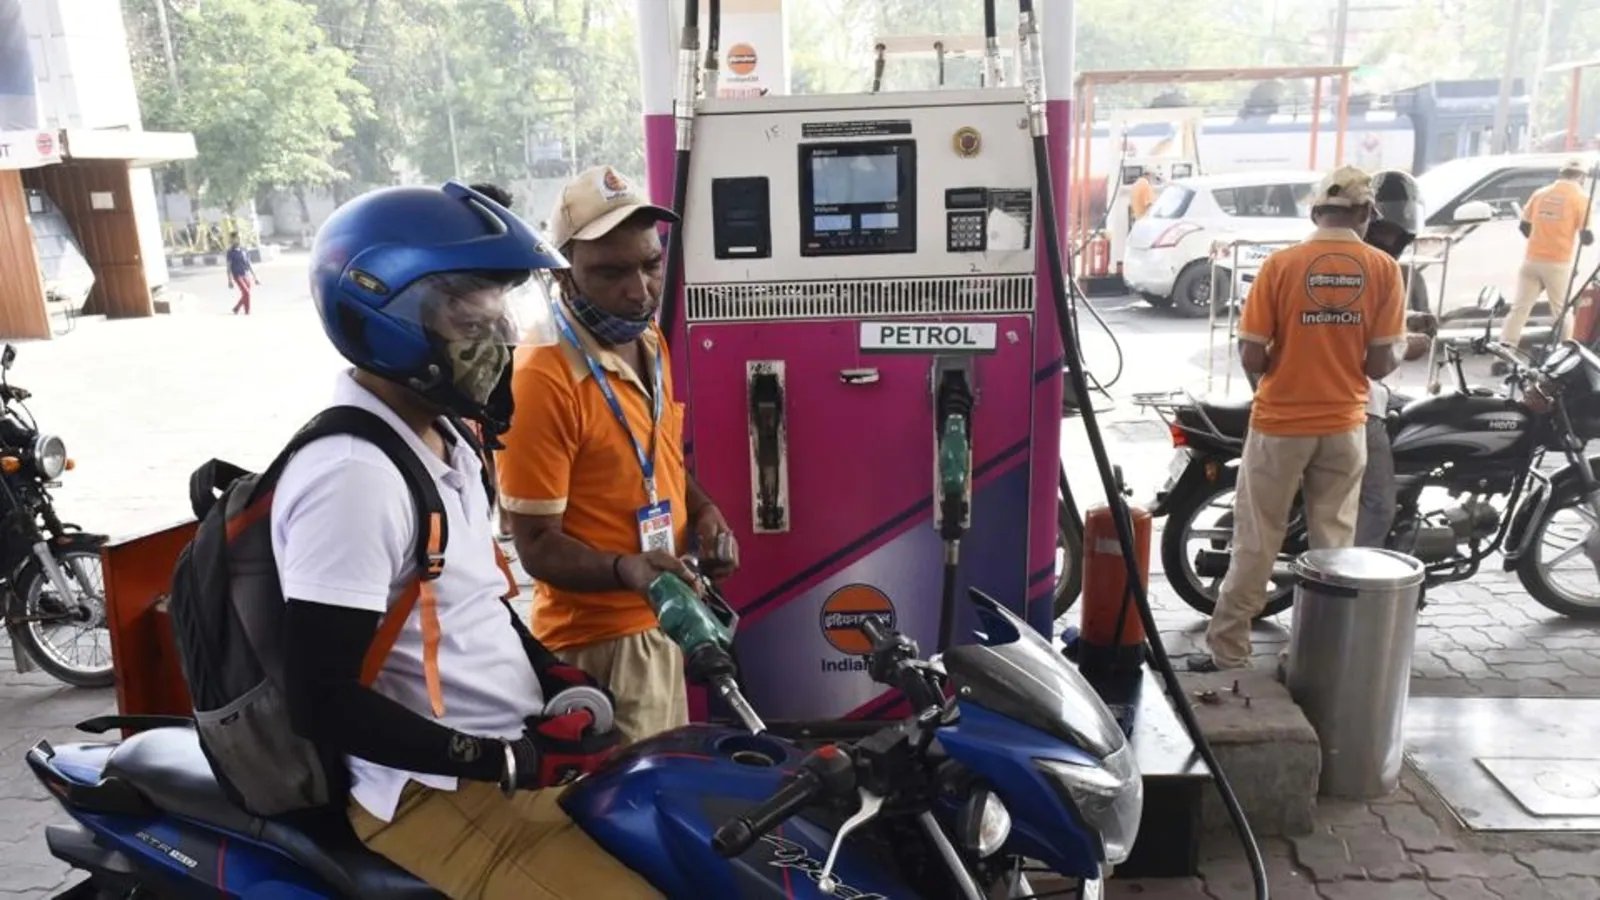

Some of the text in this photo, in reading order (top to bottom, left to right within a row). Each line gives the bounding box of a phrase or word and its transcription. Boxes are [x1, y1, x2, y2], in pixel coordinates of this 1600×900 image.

[1302, 312, 1361, 325] IndianOil
[880, 326, 977, 345] PETROL
[821, 658, 874, 672] Indian
